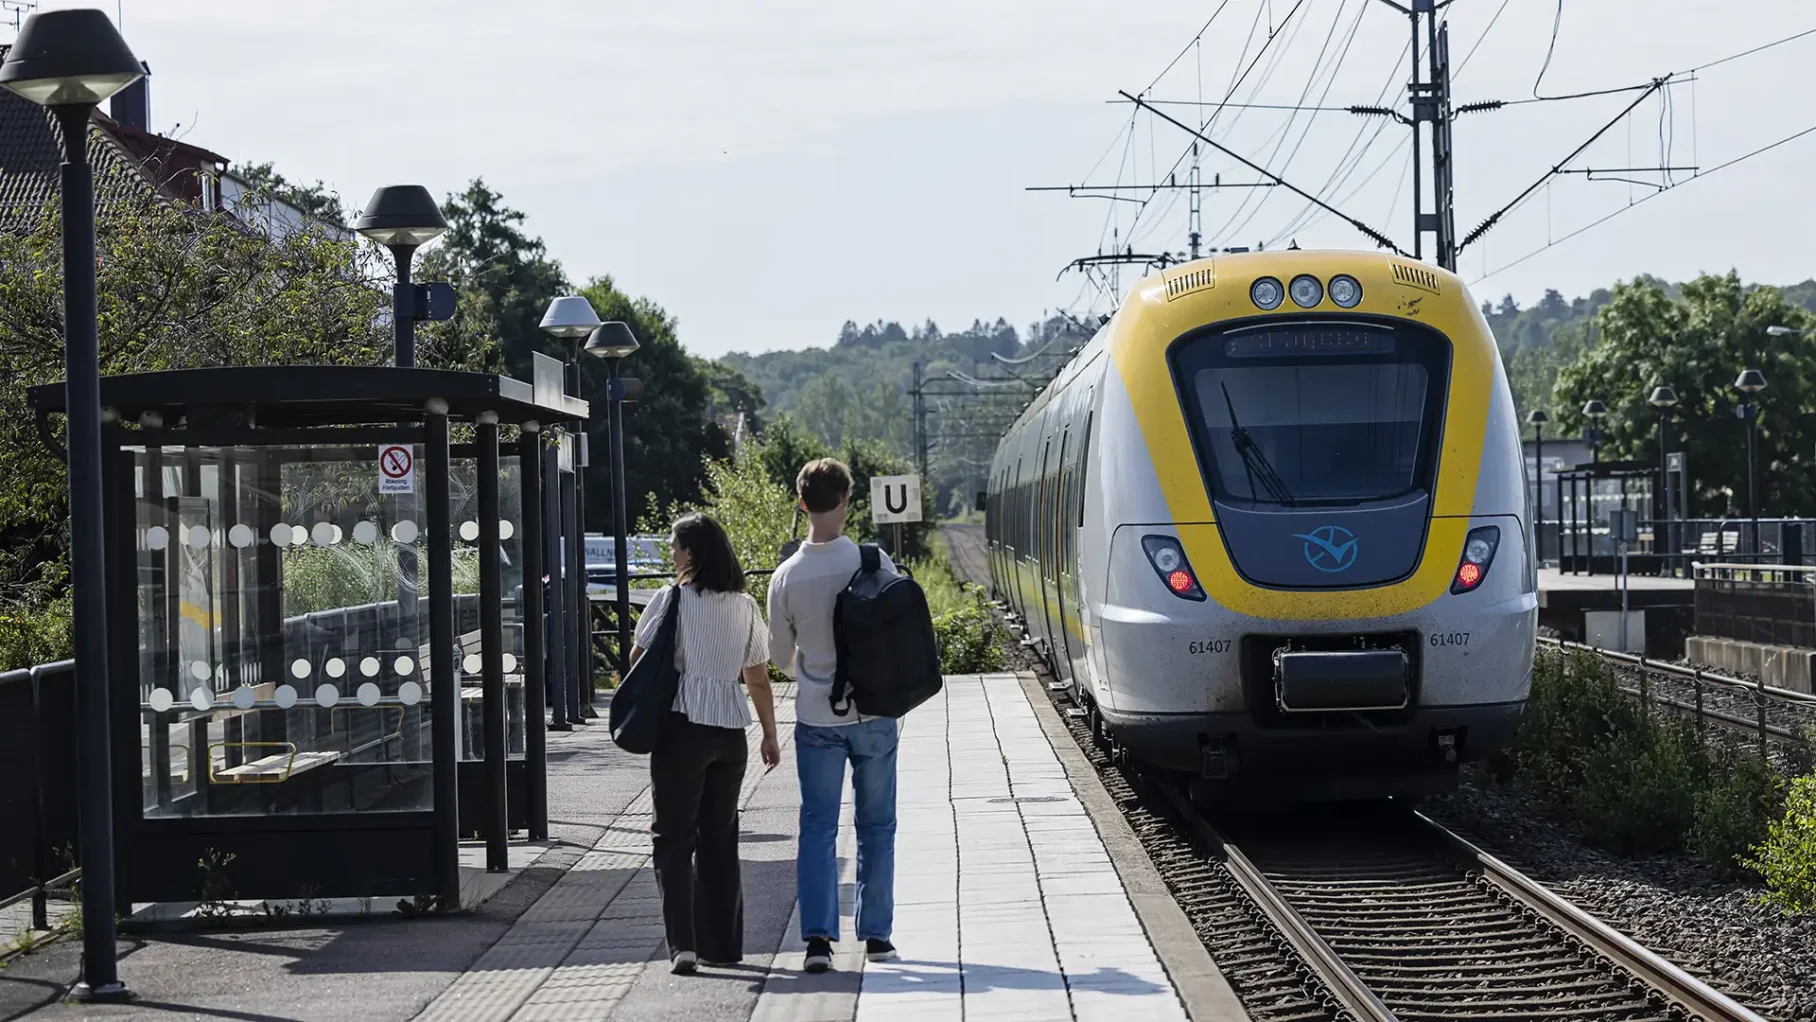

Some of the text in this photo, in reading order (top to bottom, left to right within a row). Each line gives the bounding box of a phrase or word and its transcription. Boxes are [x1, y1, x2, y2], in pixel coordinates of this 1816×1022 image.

[885, 484, 907, 514] U
[1430, 632, 1470, 646] 61407
[1189, 640, 1231, 654] 61407
